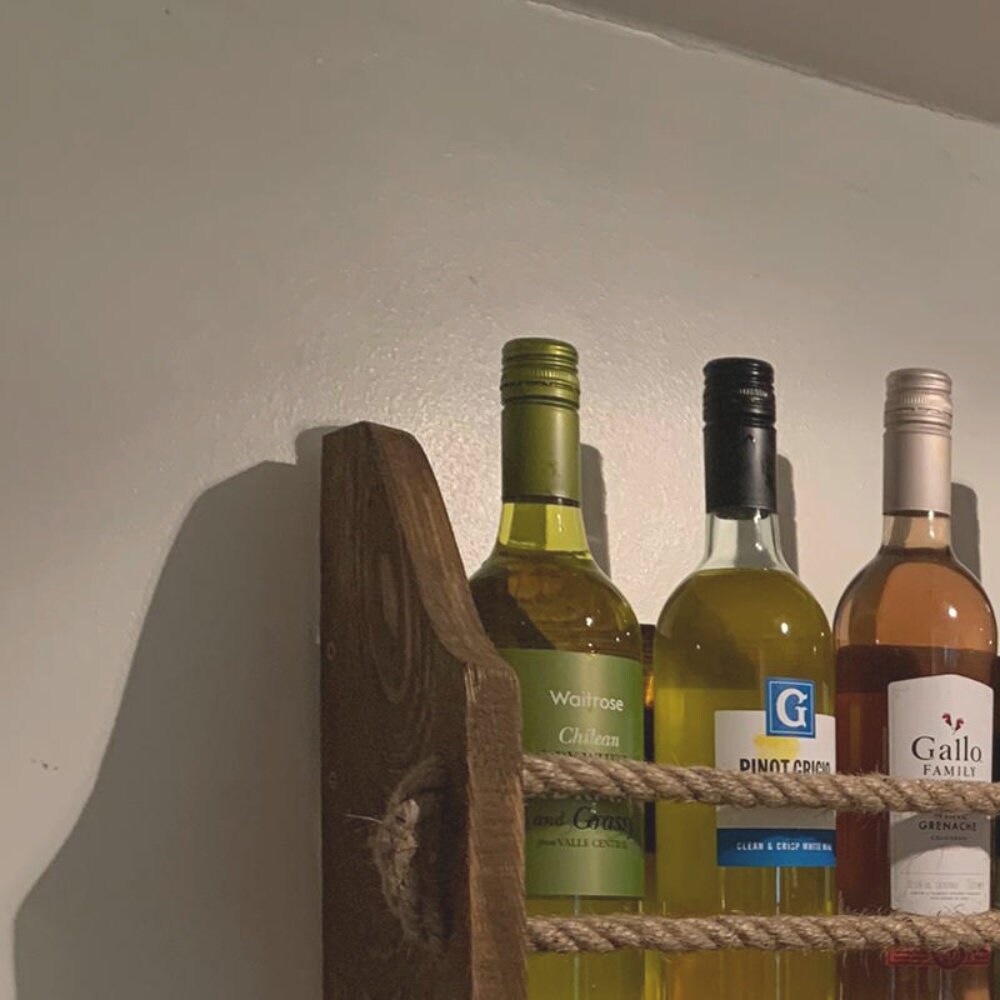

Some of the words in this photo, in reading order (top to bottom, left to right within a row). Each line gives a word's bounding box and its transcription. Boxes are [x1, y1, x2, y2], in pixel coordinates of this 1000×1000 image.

[550, 689, 625, 712] Waitrose
[775, 687, 808, 728] G
[558, 726, 620, 748] Chilean
[911, 735, 983, 764] Gallo
[739, 758, 790, 775] PINOT
[922, 763, 977, 778] FAMILY
[918, 820, 977, 832] GRENACHE
[736, 842, 765, 851] CLEAN
